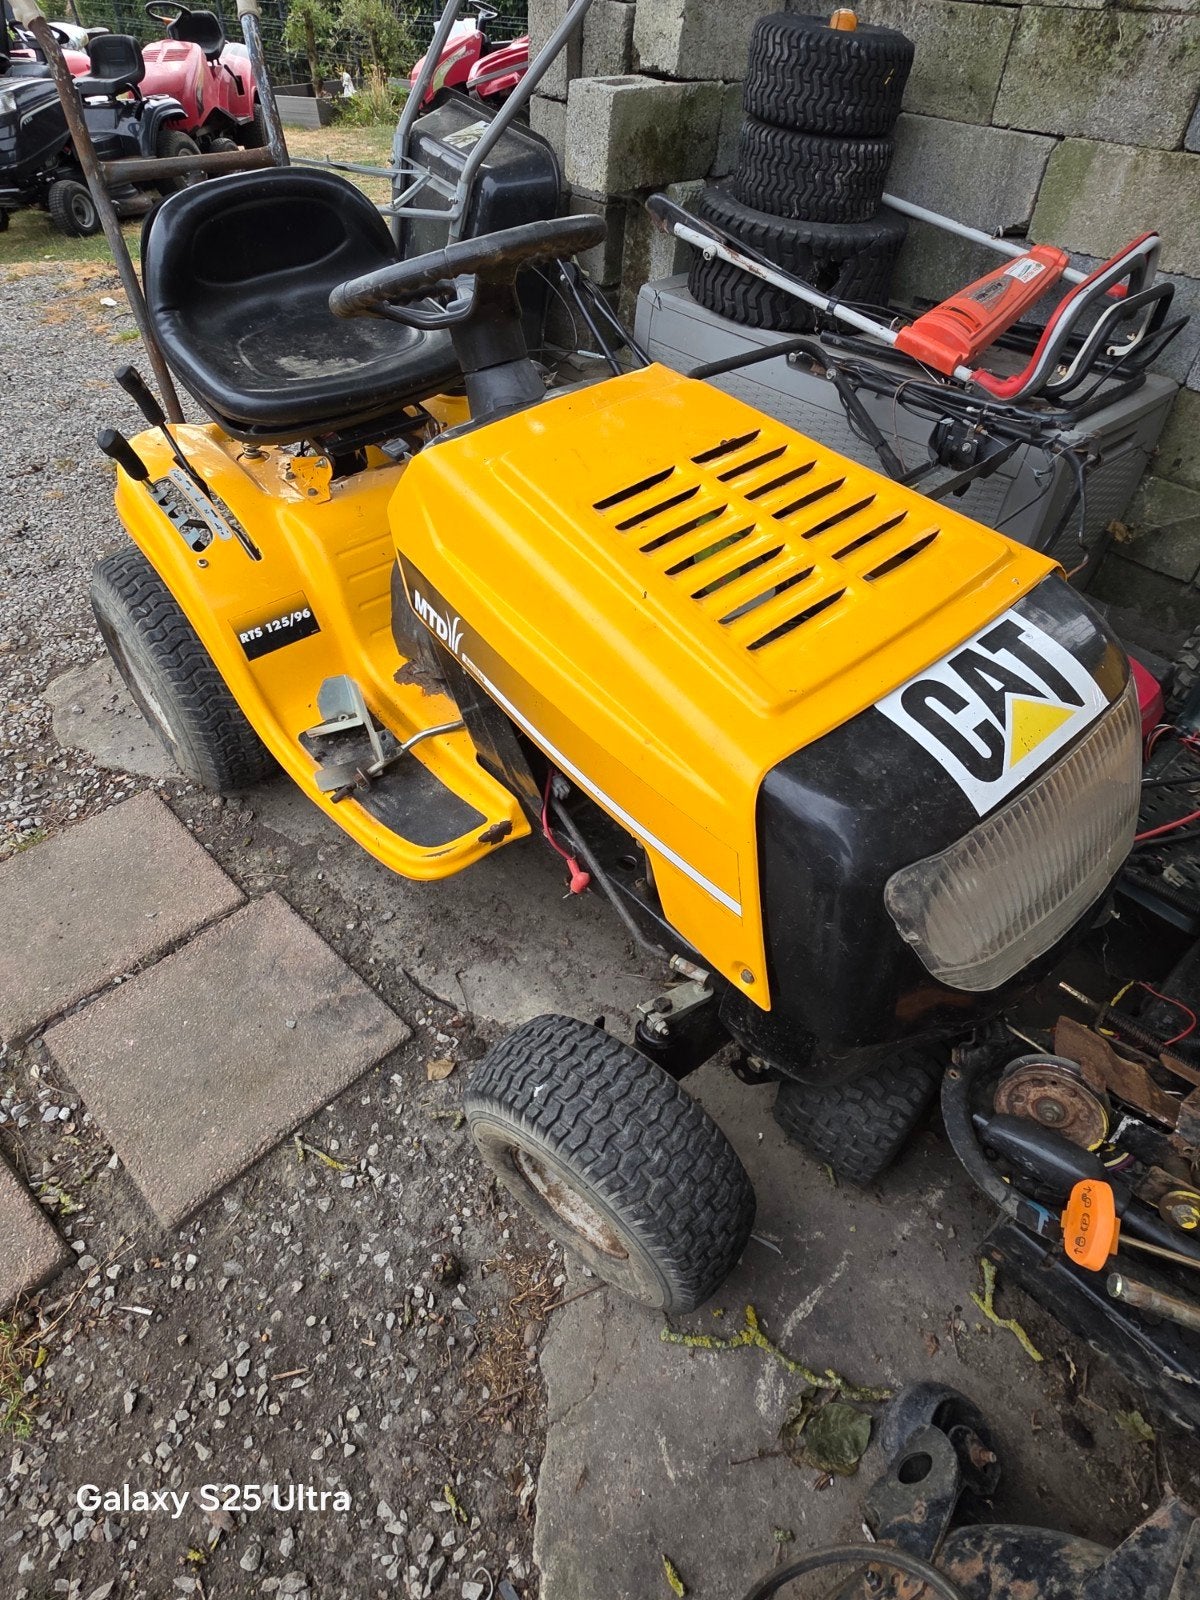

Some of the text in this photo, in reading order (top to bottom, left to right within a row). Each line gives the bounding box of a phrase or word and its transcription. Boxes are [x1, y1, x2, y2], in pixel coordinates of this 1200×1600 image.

[239, 608, 311, 644] RTS 125/96
[414, 589, 448, 641] MTD
[901, 619, 1085, 782] CAT
